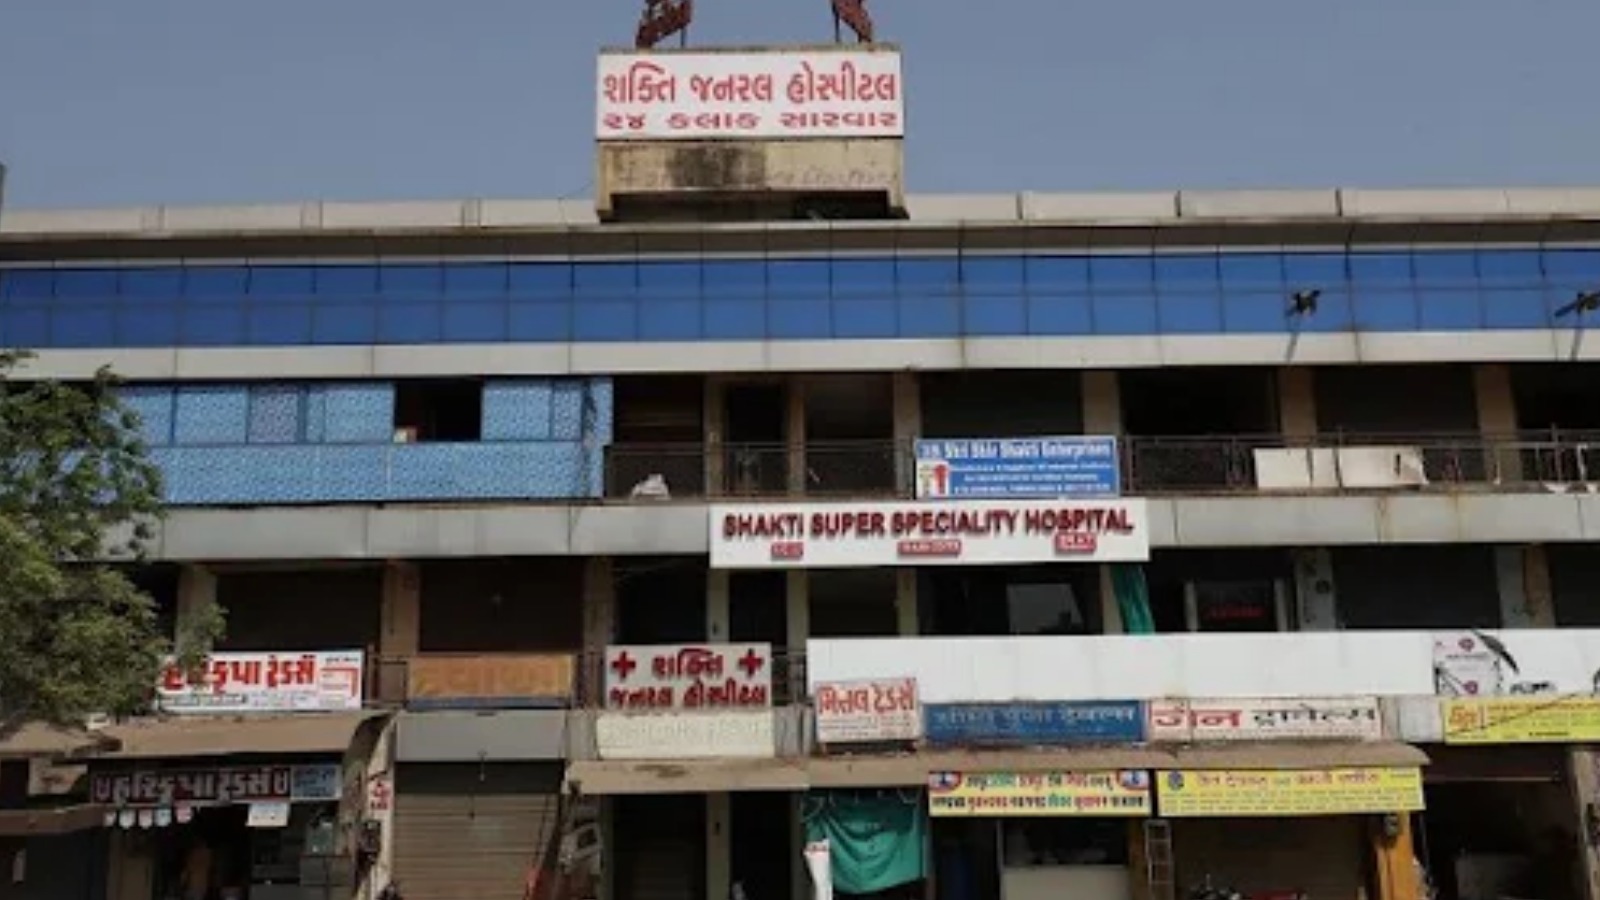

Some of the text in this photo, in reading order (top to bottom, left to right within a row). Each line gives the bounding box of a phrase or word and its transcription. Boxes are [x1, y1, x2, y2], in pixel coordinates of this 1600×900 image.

[602, 60, 896, 103] શક્તિ જનરલ હોસ્પીટલ
[666, 112, 761, 129] કલાક
[779, 111, 897, 128] સારવાર
[811, 512, 884, 537] SUPER
[891, 510, 1018, 536] SPECIALITY
[1025, 508, 1134, 535] HOSPITAL
[651, 648, 724, 680] શક્તિ
[609, 677, 767, 709] જનરલ હોસ્પીટલ
